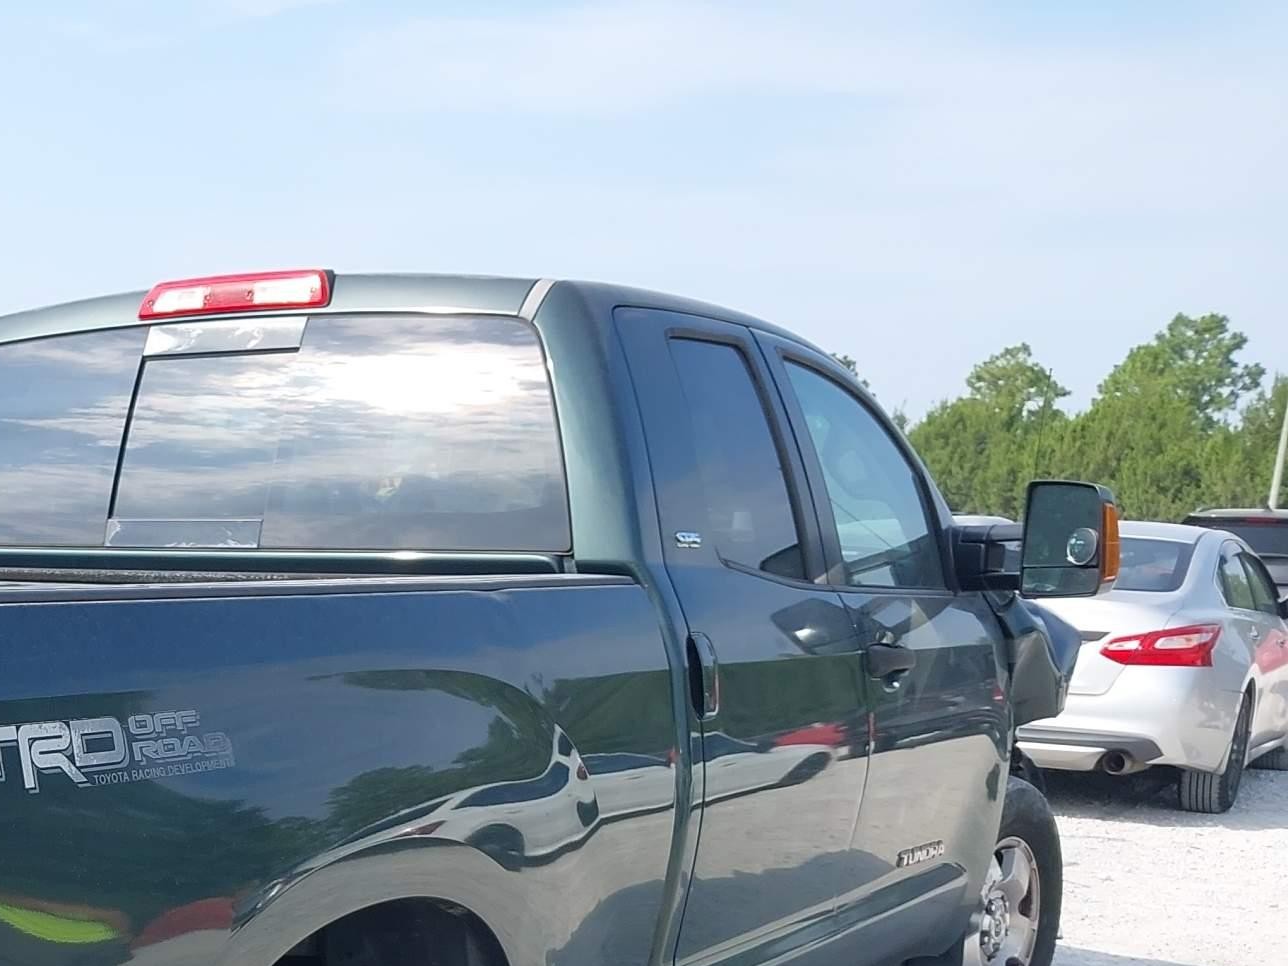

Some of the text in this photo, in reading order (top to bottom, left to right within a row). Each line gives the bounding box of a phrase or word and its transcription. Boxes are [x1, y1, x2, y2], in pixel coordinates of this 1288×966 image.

[128, 709, 200, 738] OFF
[131, 732, 233, 765] ROAD
[93, 758, 234, 786] TOYOTA RACING DEVELOPMENT
[899, 841, 945, 867] TUNDRA
